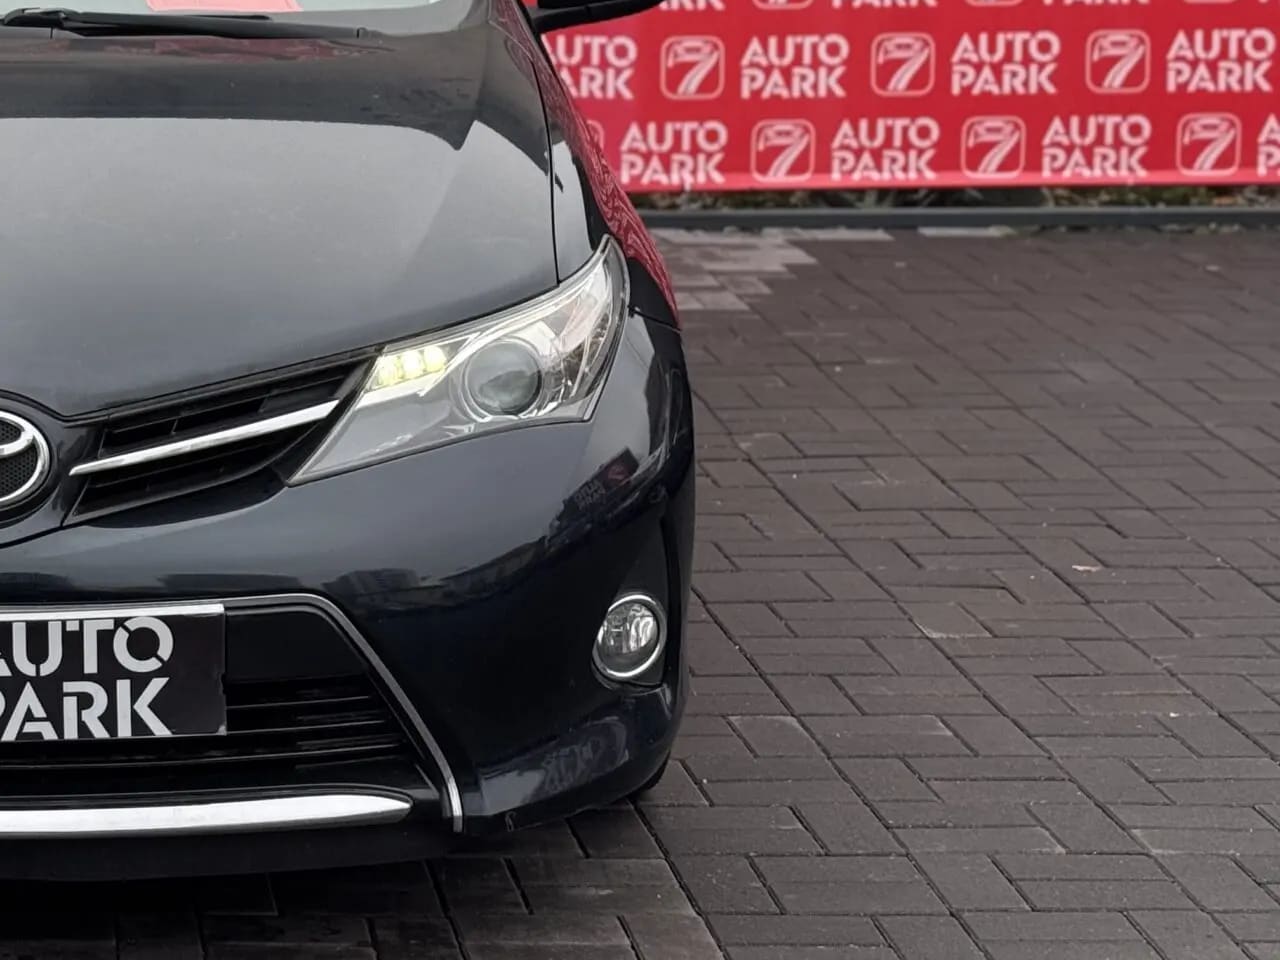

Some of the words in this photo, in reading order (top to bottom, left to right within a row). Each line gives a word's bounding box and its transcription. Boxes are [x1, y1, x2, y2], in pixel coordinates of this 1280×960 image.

[741, 34, 849, 67] AUTO
[952, 31, 1060, 64] AUTO
[1167, 29, 1275, 61] AUTO
[741, 66, 845, 99] PARK
[952, 63, 1056, 95] PARK
[1167, 60, 1271, 92] PARK
[620, 121, 727, 153] AUTO
[832, 117, 939, 149] AUTO
[1043, 115, 1151, 147] AUTO
[620, 153, 725, 185] PARK
[832, 149, 937, 180] PARK
[1043, 147, 1148, 178] PARK
